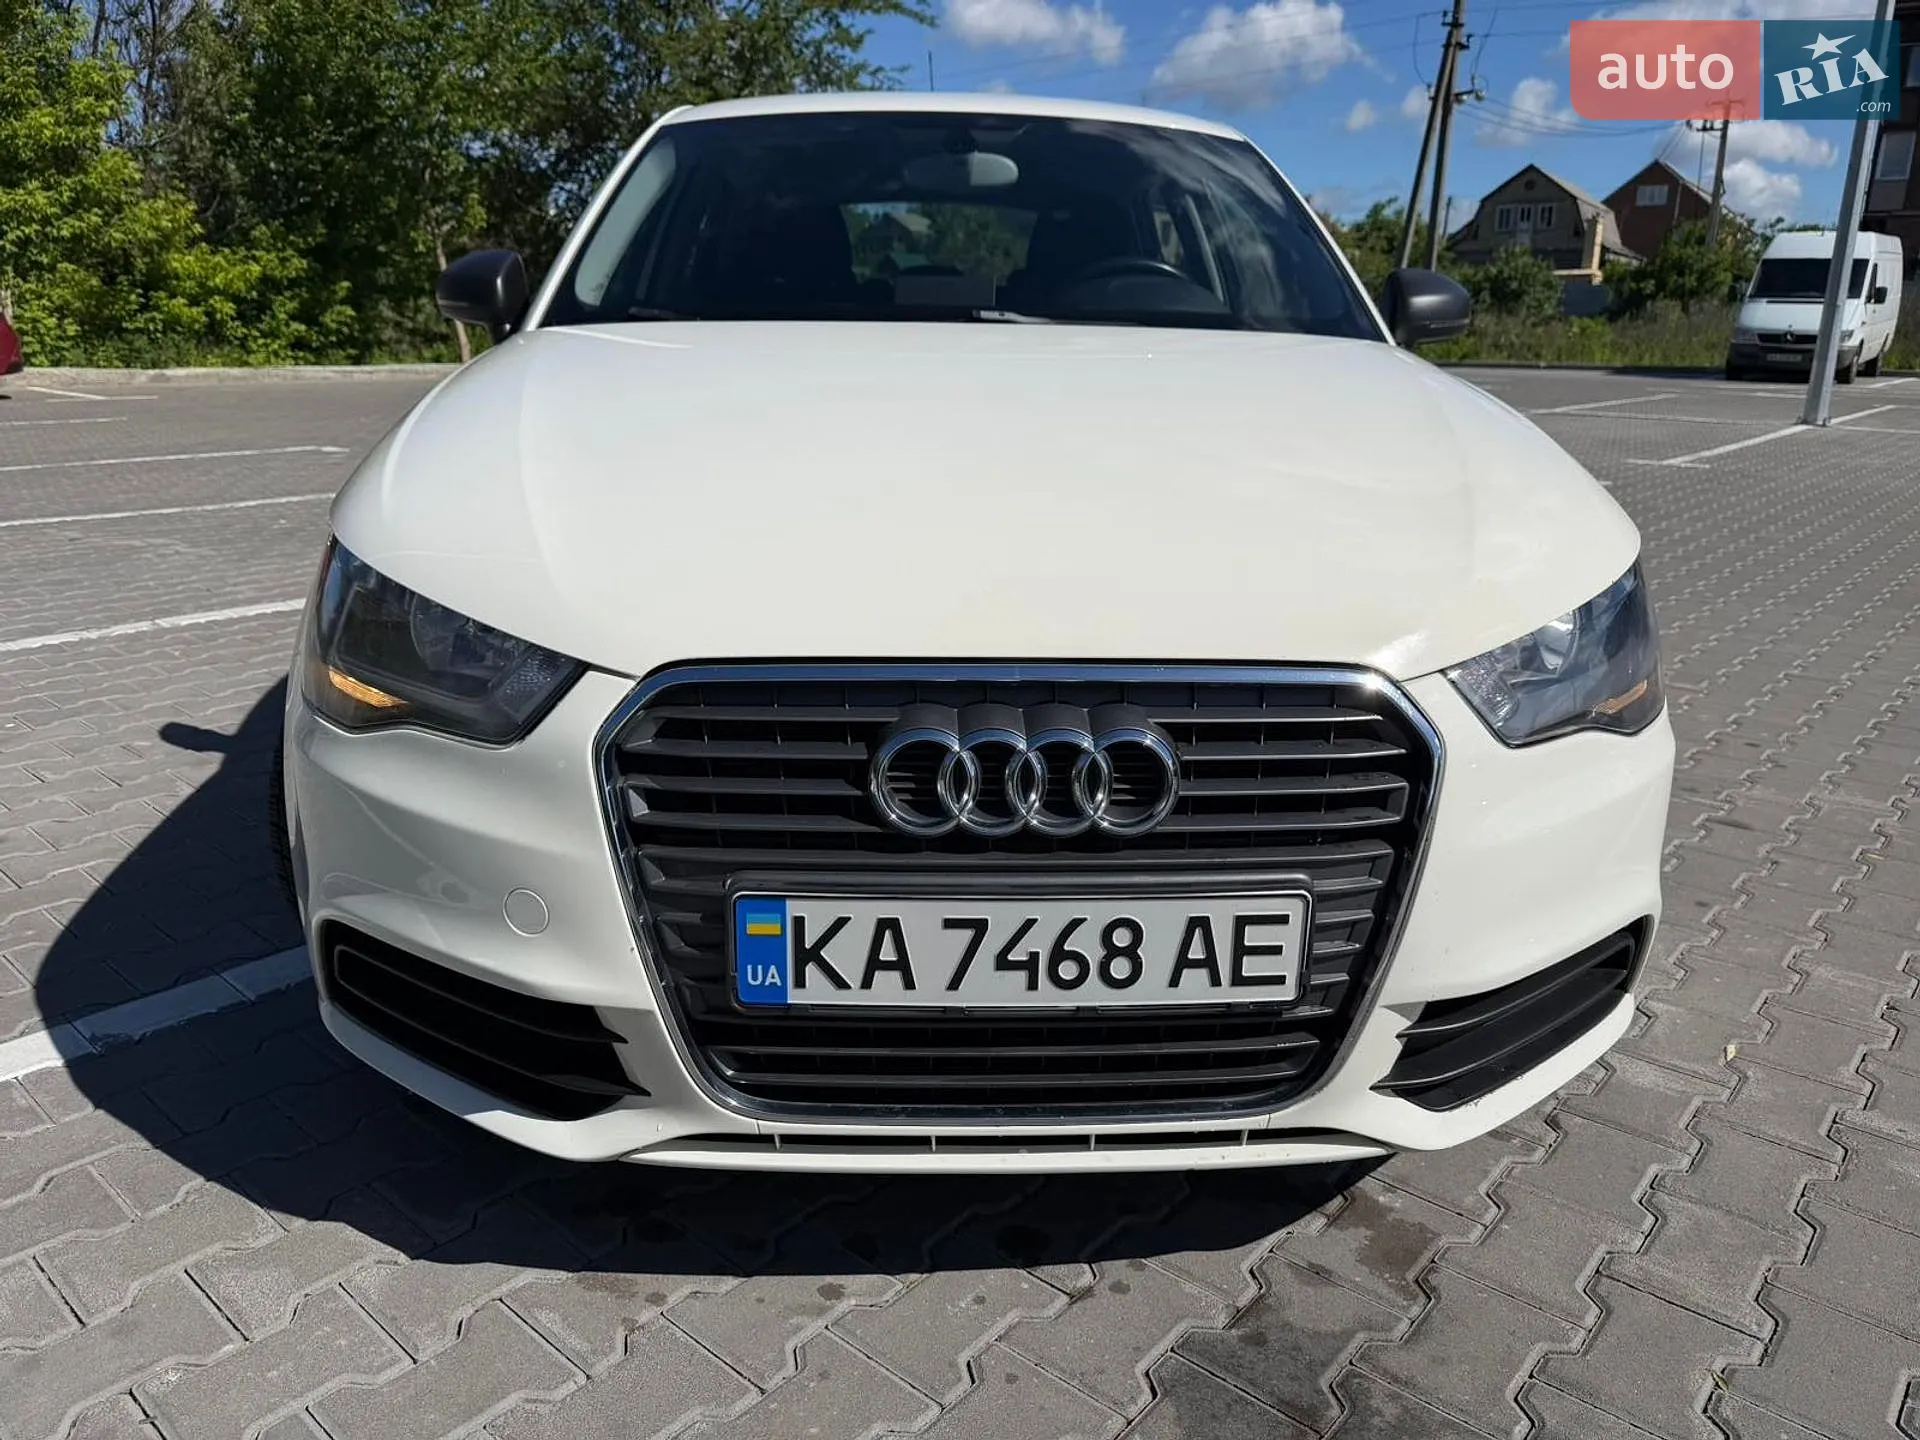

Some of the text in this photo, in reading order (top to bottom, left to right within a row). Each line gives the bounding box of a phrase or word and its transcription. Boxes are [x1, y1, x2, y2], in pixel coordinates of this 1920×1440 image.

[746, 964, 782, 987] UA
[792, 913, 1292, 992] KA 7468 AE
